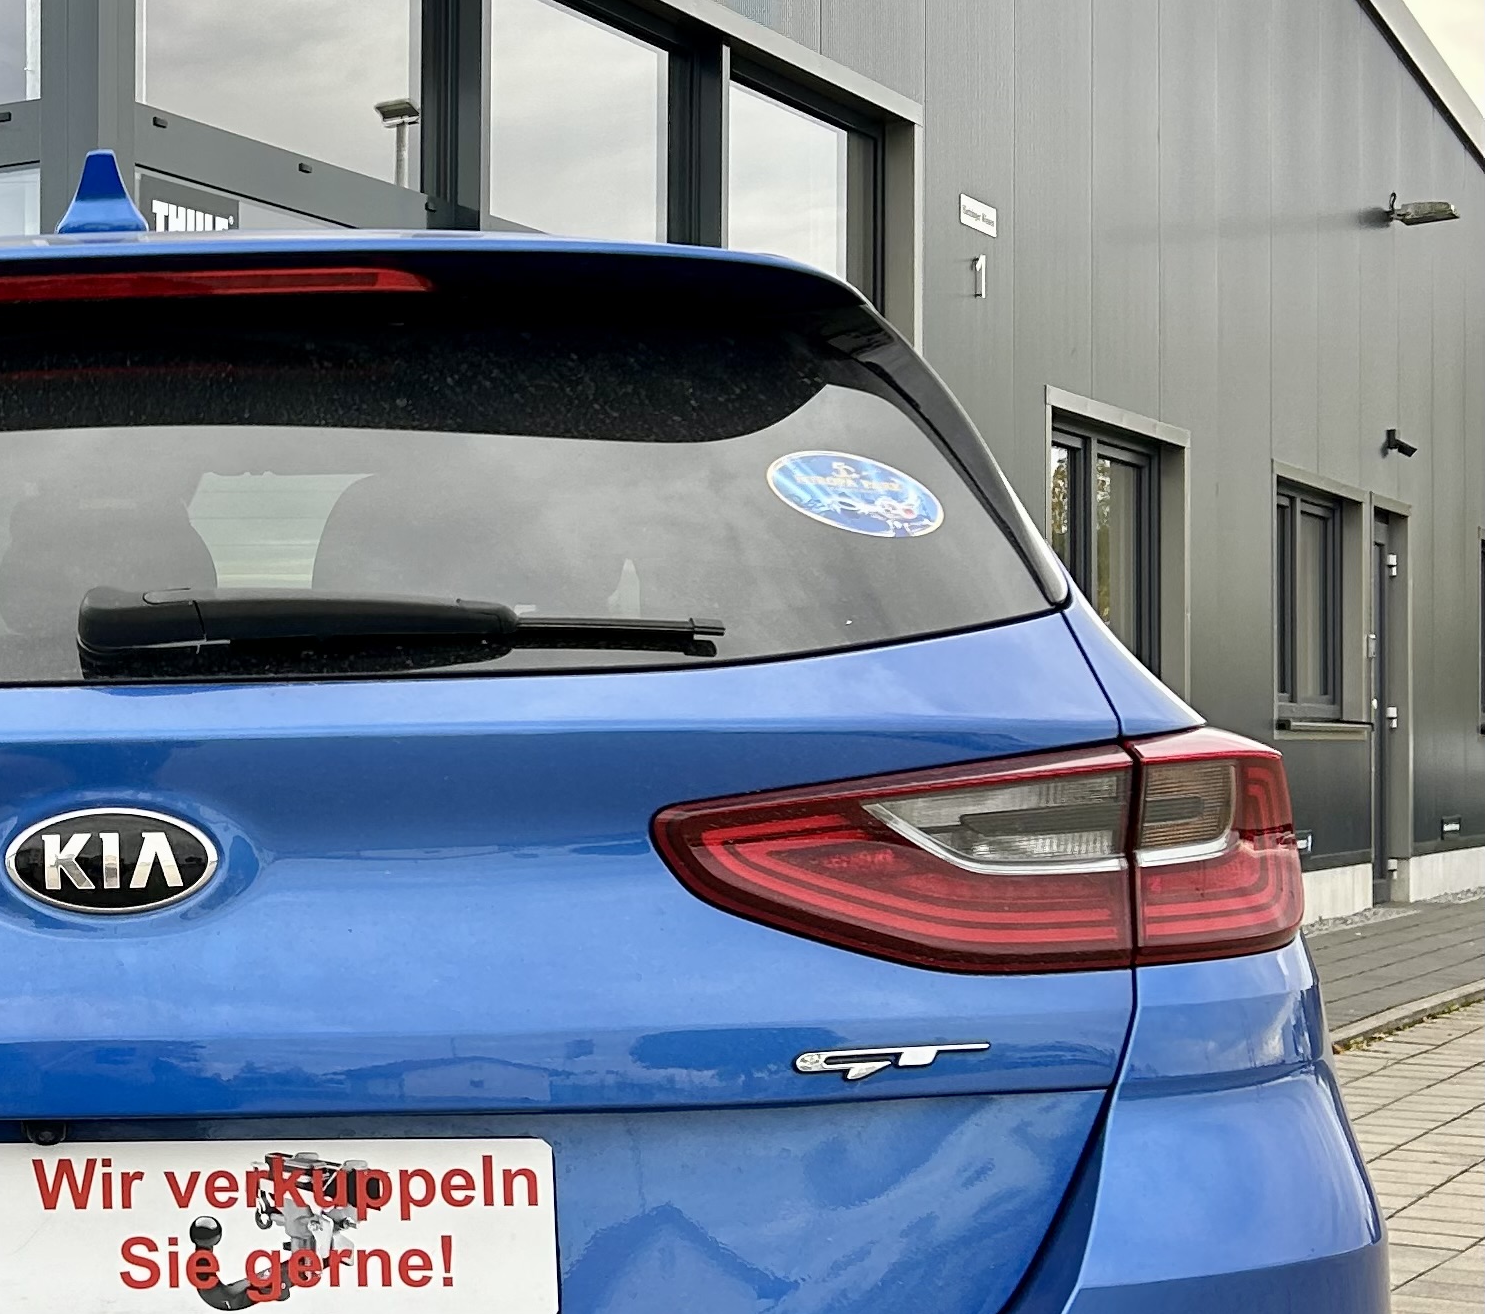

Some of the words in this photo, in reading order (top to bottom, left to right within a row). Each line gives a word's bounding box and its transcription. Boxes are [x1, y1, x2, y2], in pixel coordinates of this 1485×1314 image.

[975, 254, 986, 298] 1
[41, 831, 184, 890] KIA
[796, 1043, 991, 1080] GT
[32, 1157, 144, 1210] Wir
[164, 1155, 539, 1221] verkuppeln
[120, 1236, 220, 1290] Sie
[246, 1234, 454, 1302] gerne!
